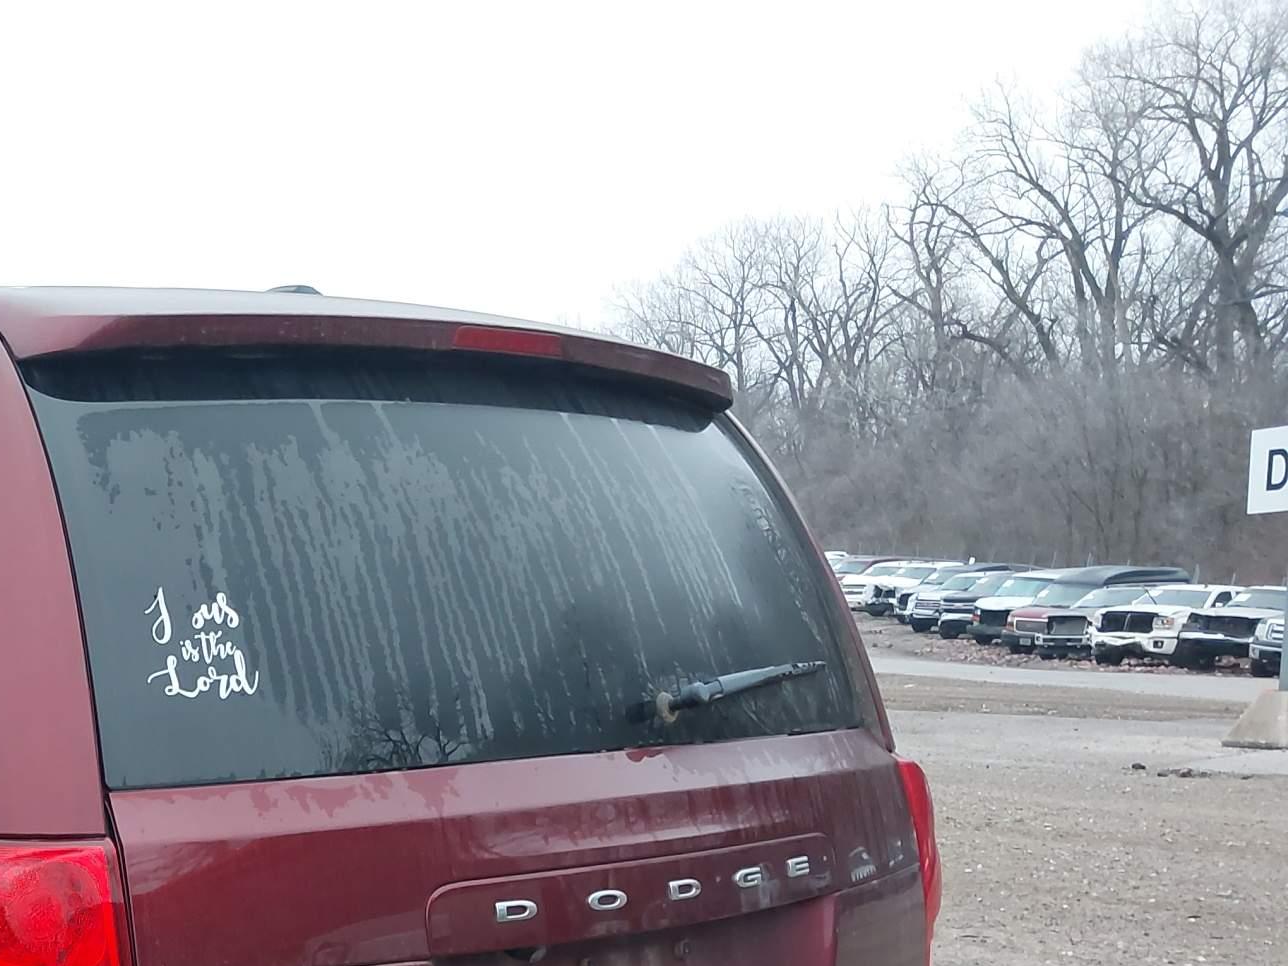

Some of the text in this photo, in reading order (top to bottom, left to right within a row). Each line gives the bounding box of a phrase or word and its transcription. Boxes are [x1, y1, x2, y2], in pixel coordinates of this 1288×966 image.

[179, 630, 237, 665] is the
[147, 649, 260, 700] Lord
[494, 854, 810, 924] DODGE
